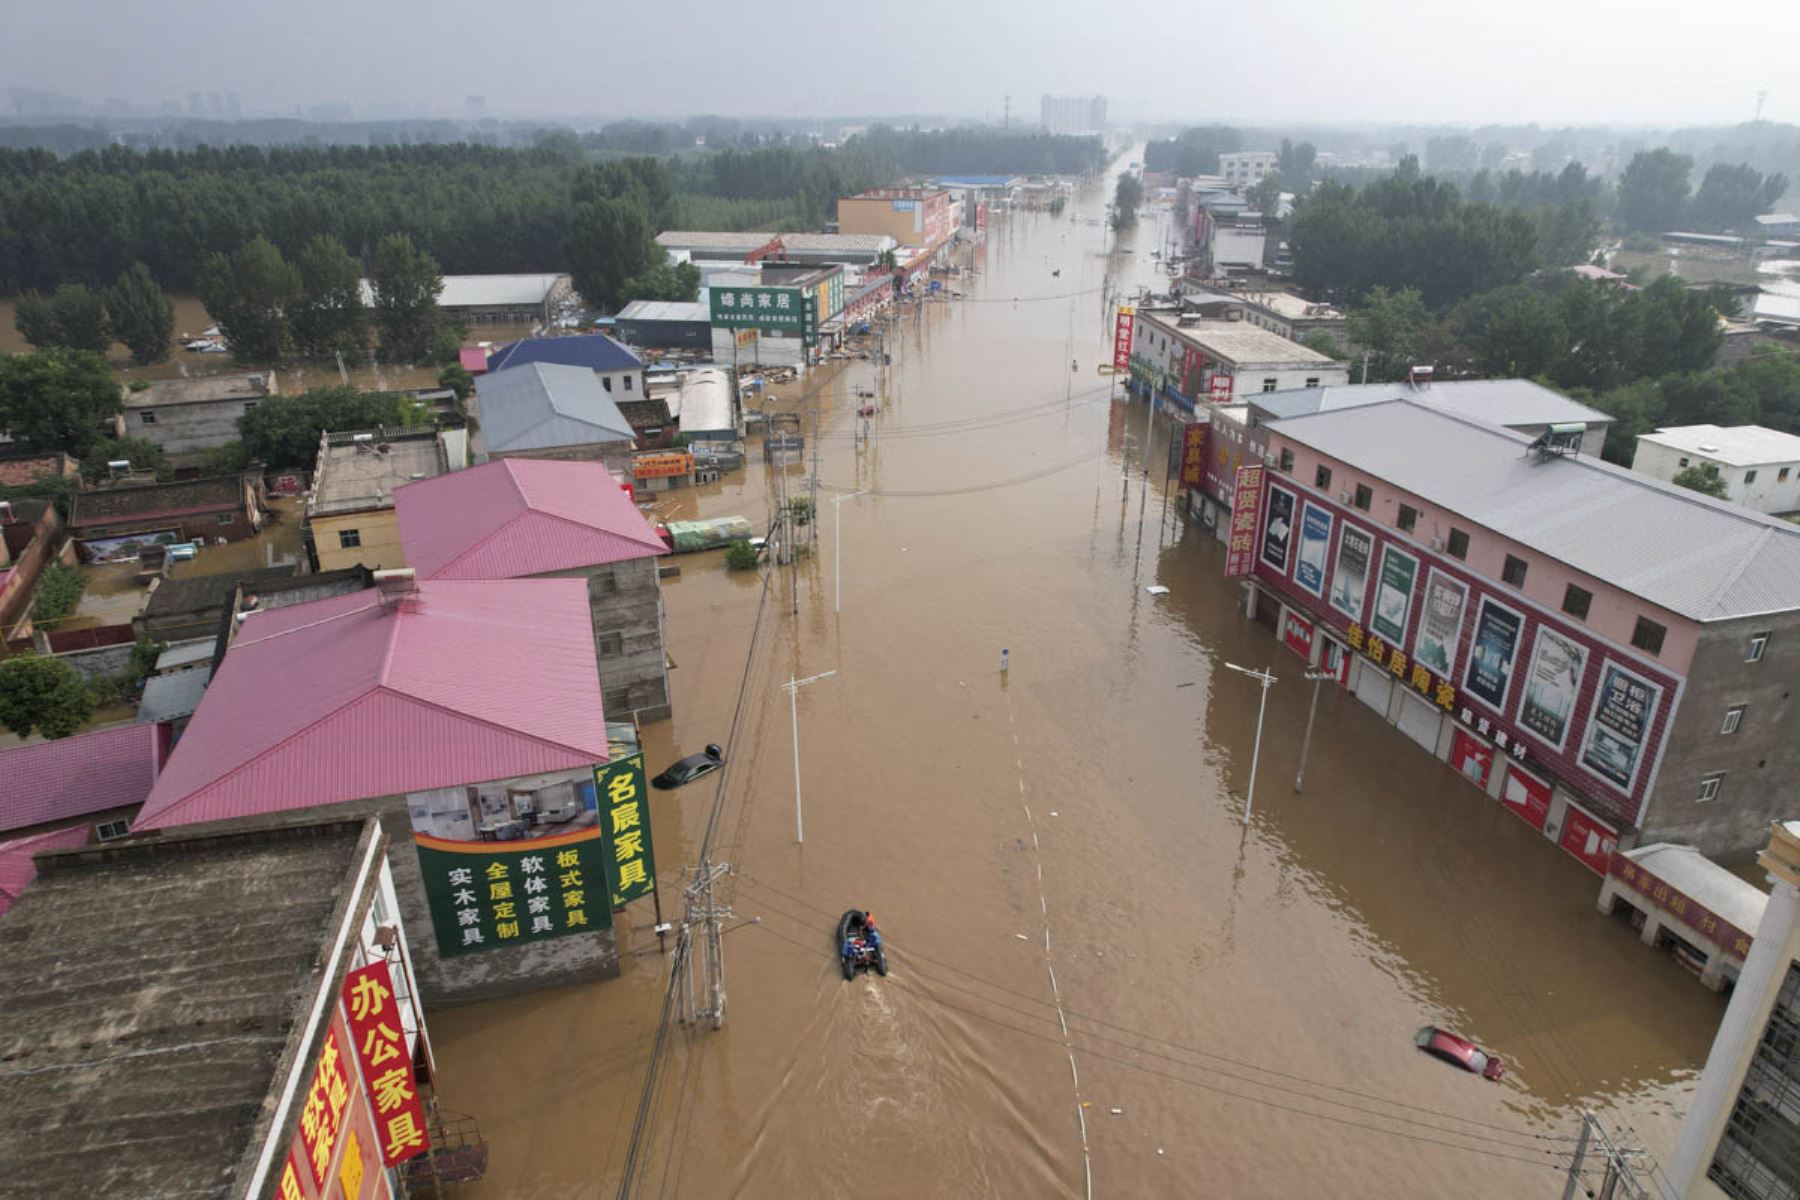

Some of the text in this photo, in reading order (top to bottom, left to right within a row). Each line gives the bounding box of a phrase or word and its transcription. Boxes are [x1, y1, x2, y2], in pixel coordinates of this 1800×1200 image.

[448, 867, 485, 946] 实木家具
[485, 862, 520, 939] 全屋定制
[520, 855, 554, 933] 软体家具
[556, 849, 588, 928] 板式家具
[350, 974, 424, 1160] 办公家具
